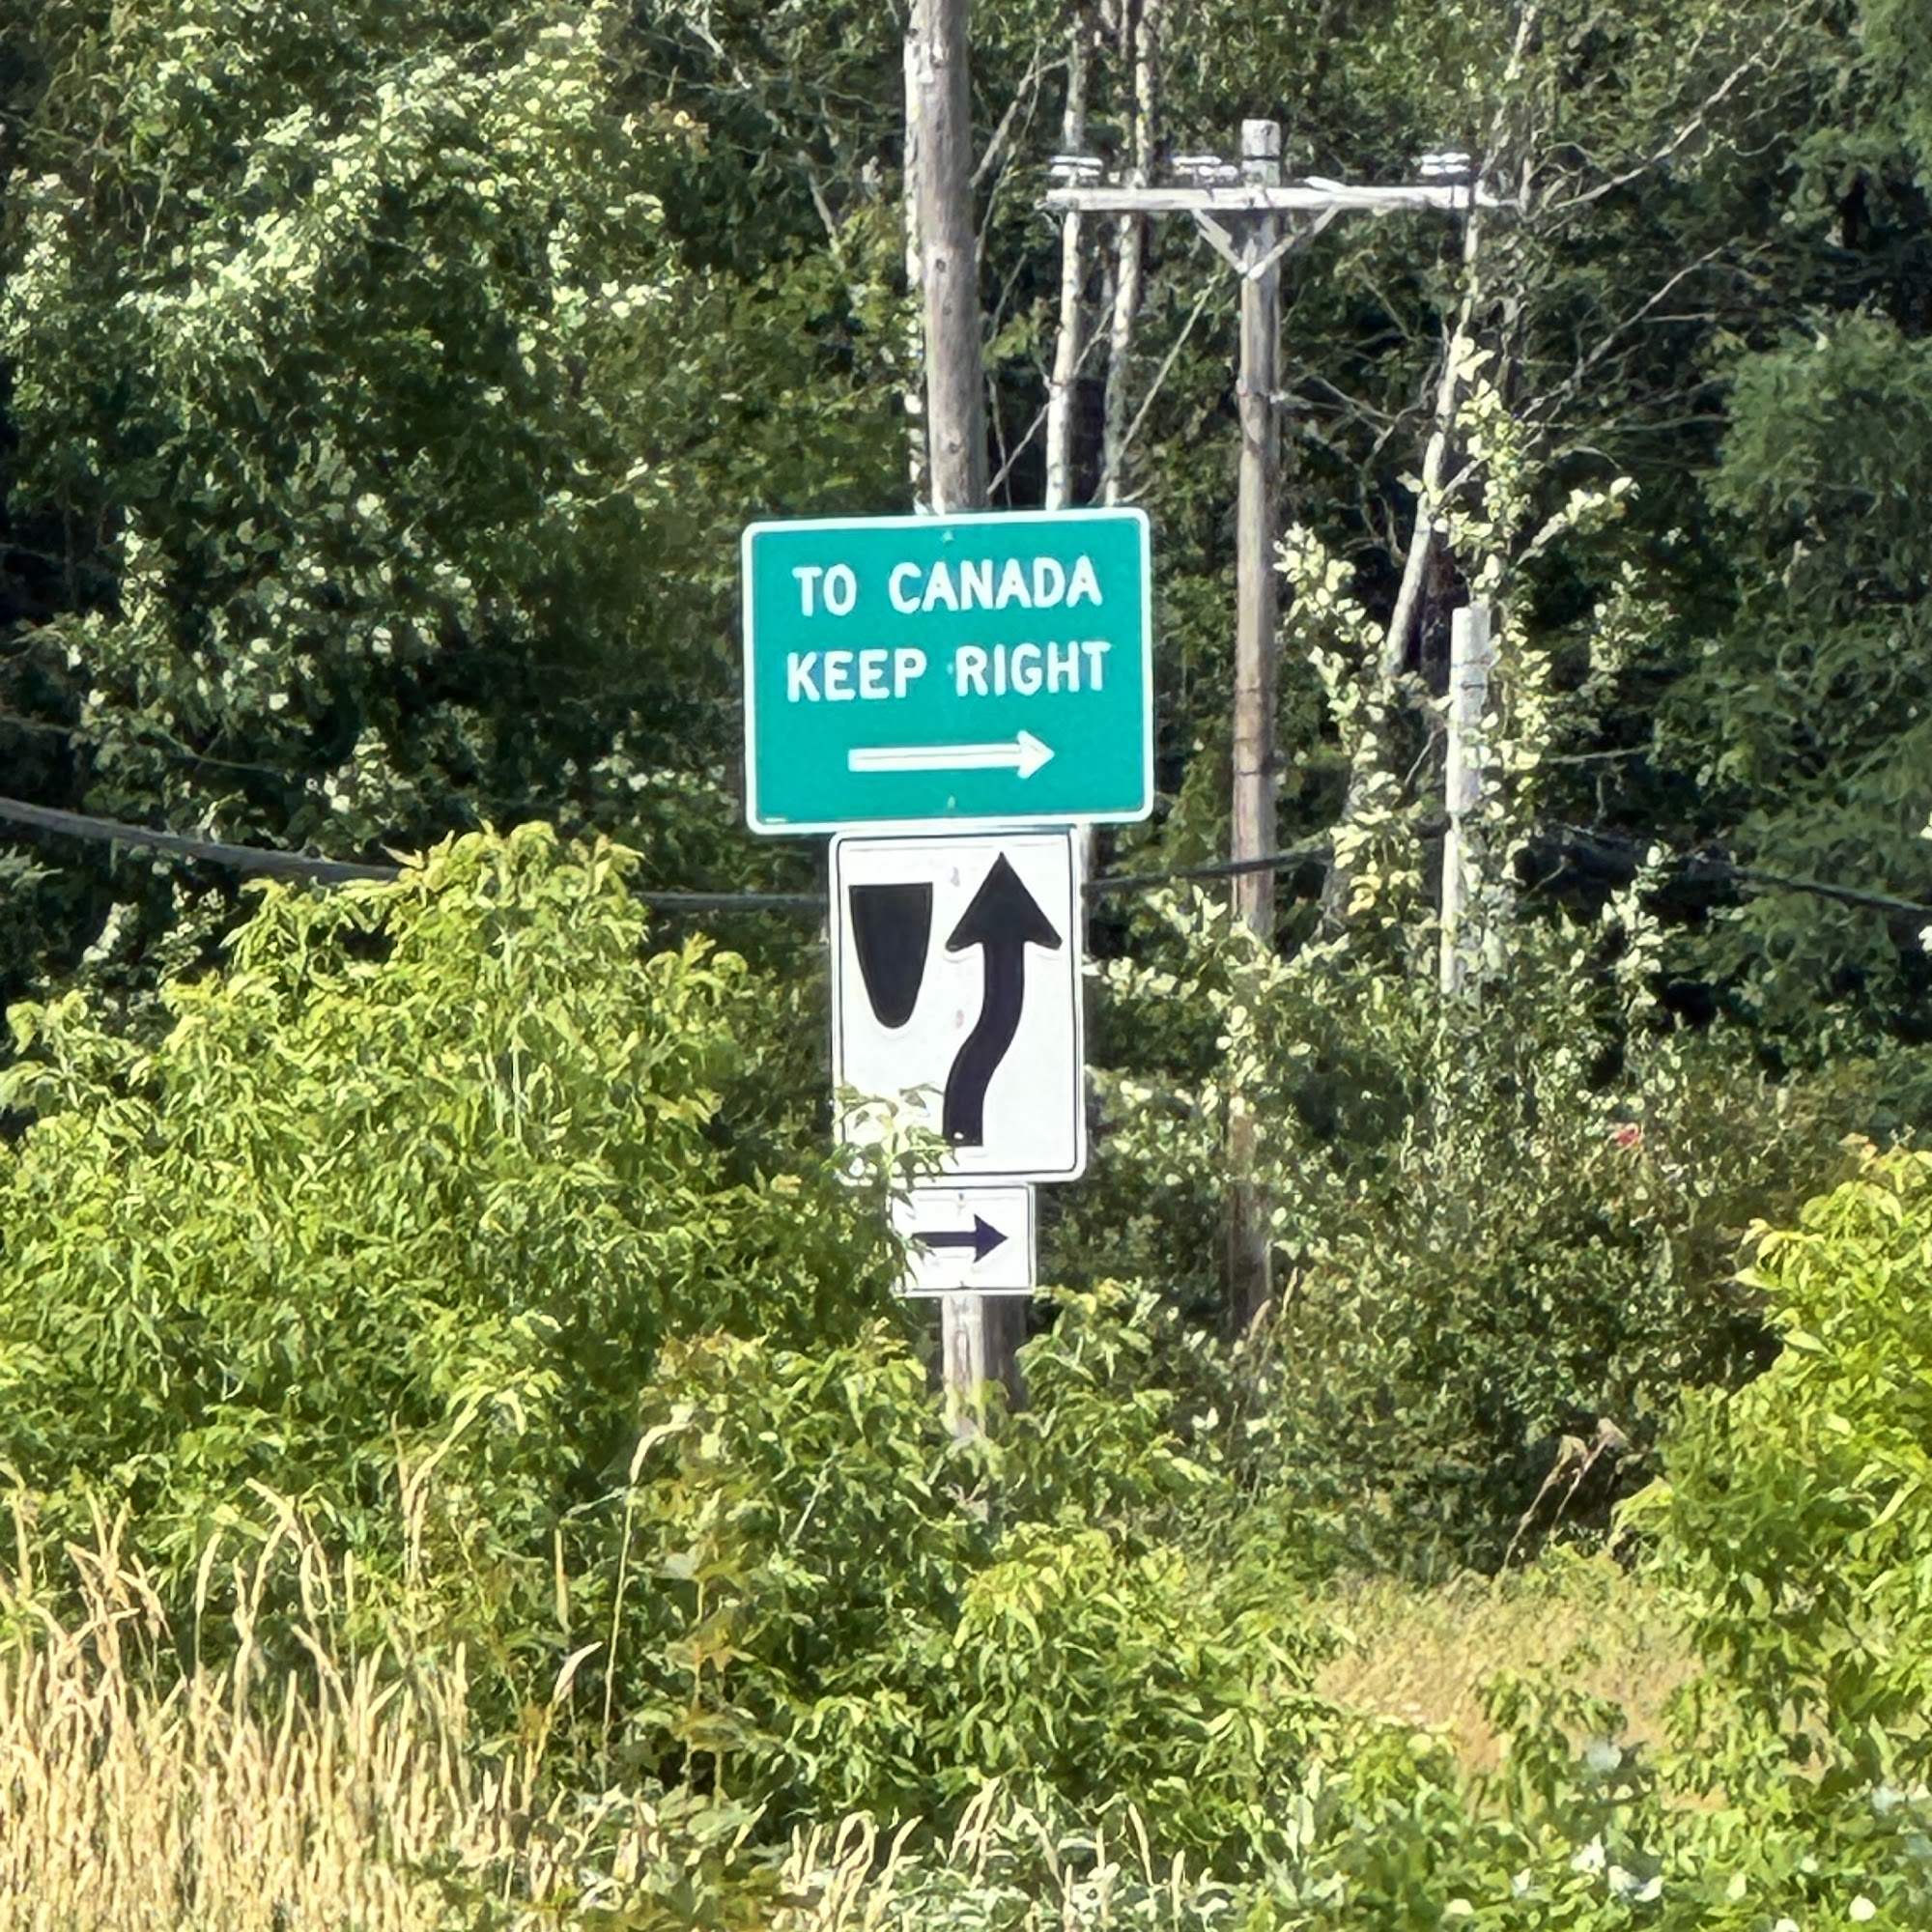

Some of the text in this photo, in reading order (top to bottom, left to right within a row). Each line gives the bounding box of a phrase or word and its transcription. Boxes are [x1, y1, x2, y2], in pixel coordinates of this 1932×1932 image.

[792, 555, 1102, 616] TO CANADA
[787, 641, 1111, 702] KEEP RIGHT
